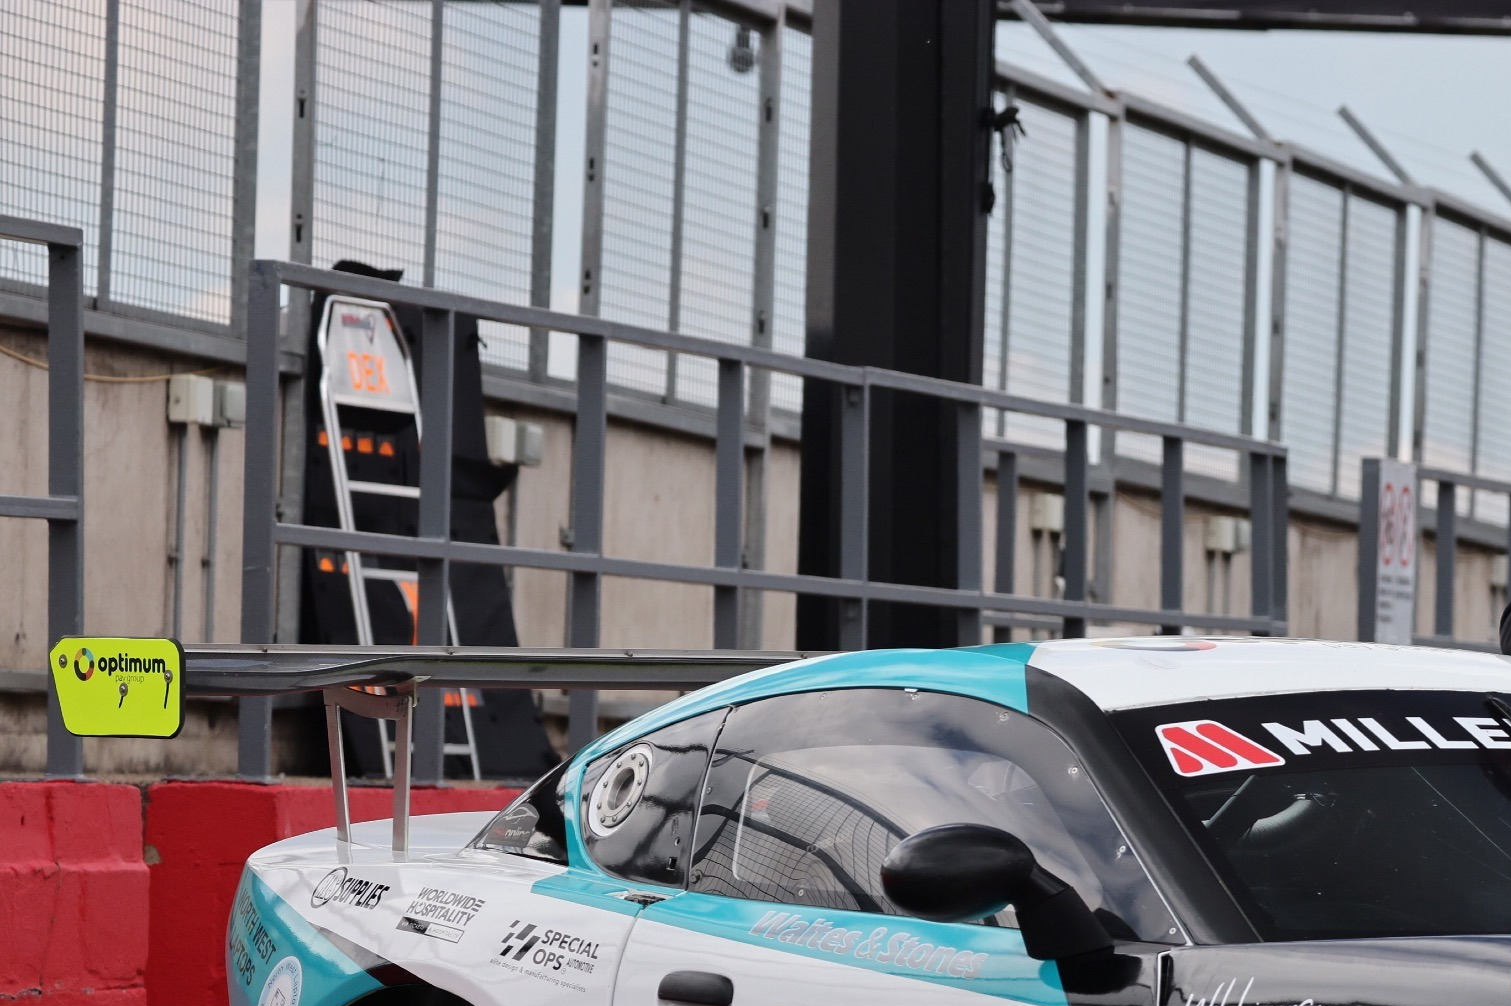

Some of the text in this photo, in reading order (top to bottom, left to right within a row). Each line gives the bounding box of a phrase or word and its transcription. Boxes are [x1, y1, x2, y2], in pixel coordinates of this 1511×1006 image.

[348, 351, 390, 395] DEX
[98, 653, 166, 676] optimum
[127, 675, 145, 684] group
[333, 878, 390, 910] SUPPLIES
[416, 887, 486, 913] WORLDWIDE
[237, 888, 277, 965] NORTH WEST
[405, 901, 475, 927] HOSPITALITY
[229, 928, 256, 986] LAPTOPS
[541, 929, 600, 960] SPECIAL
[854, 926, 889, 959] &
[876, 931, 989, 980] Stones
[532, 949, 595, 974] OPS AUTOMOTIVE
[502, 962, 519, 972] design
[519, 966, 524, 974] &
[524, 968, 560, 986] manufacturing
[560, 980, 586, 993] specialists
